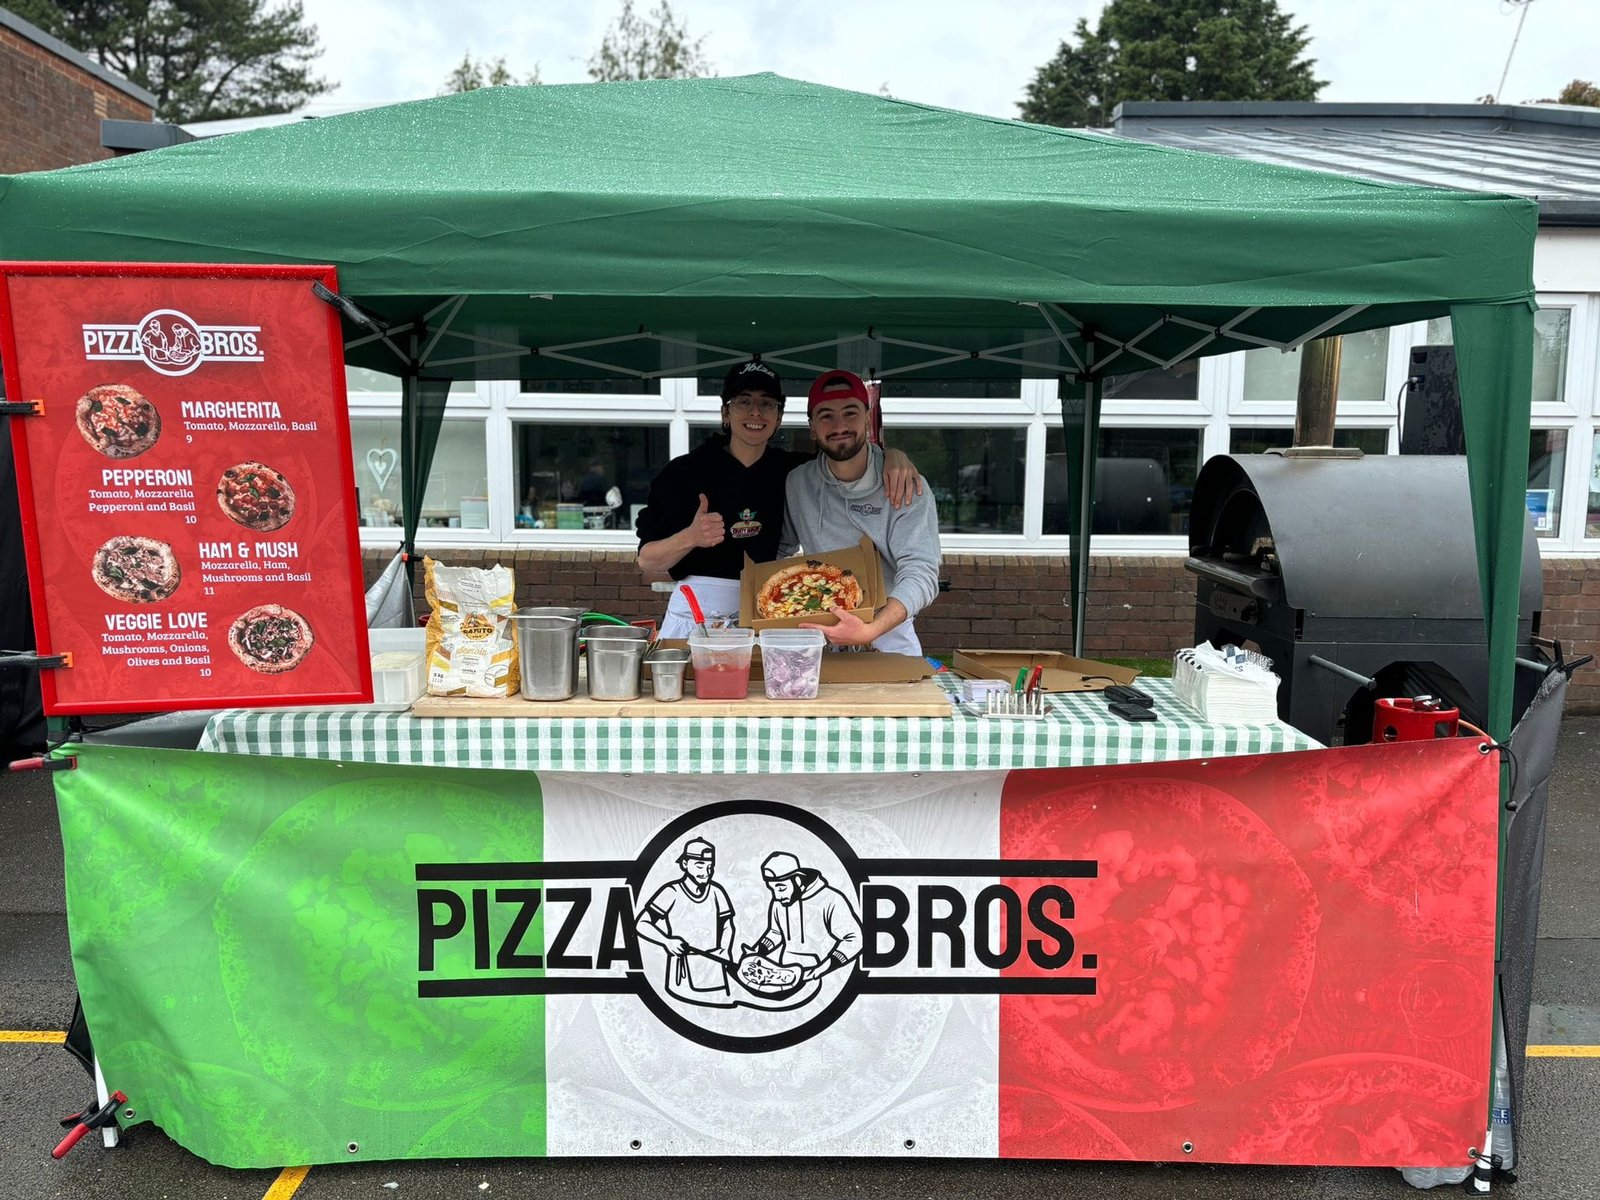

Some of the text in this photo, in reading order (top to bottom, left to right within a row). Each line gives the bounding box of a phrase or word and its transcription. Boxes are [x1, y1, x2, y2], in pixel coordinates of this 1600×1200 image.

[83, 330, 264, 355] PIZZA BROS.
[181, 401, 282, 418] MARGHERITA
[184, 421, 317, 432] Tomato, Mozzarella, Basil
[186, 434, 193, 443] 9
[102, 469, 193, 486] PEPPERONI
[88, 488, 194, 499] Tomato, Mozzarella
[88, 502, 196, 514] Pepperoni and Basil
[185, 515, 197, 524] 10
[199, 541, 299, 559] HAM & MUSH
[201, 560, 291, 571] Mozzarella, Ham,
[202, 572, 312, 583] Mushrooms and Basil
[204, 586, 215, 595] 11
[105, 612, 208, 631] VEGGIE LOVE
[101, 630, 209, 643] Tomato, Mozzarella,
[102, 643, 210, 655] Mushrooms, Onions,
[127, 655, 211, 667] Olives and Basil
[200, 668, 212, 677] 10
[417, 884, 1098, 972] PIZZA BROS.
